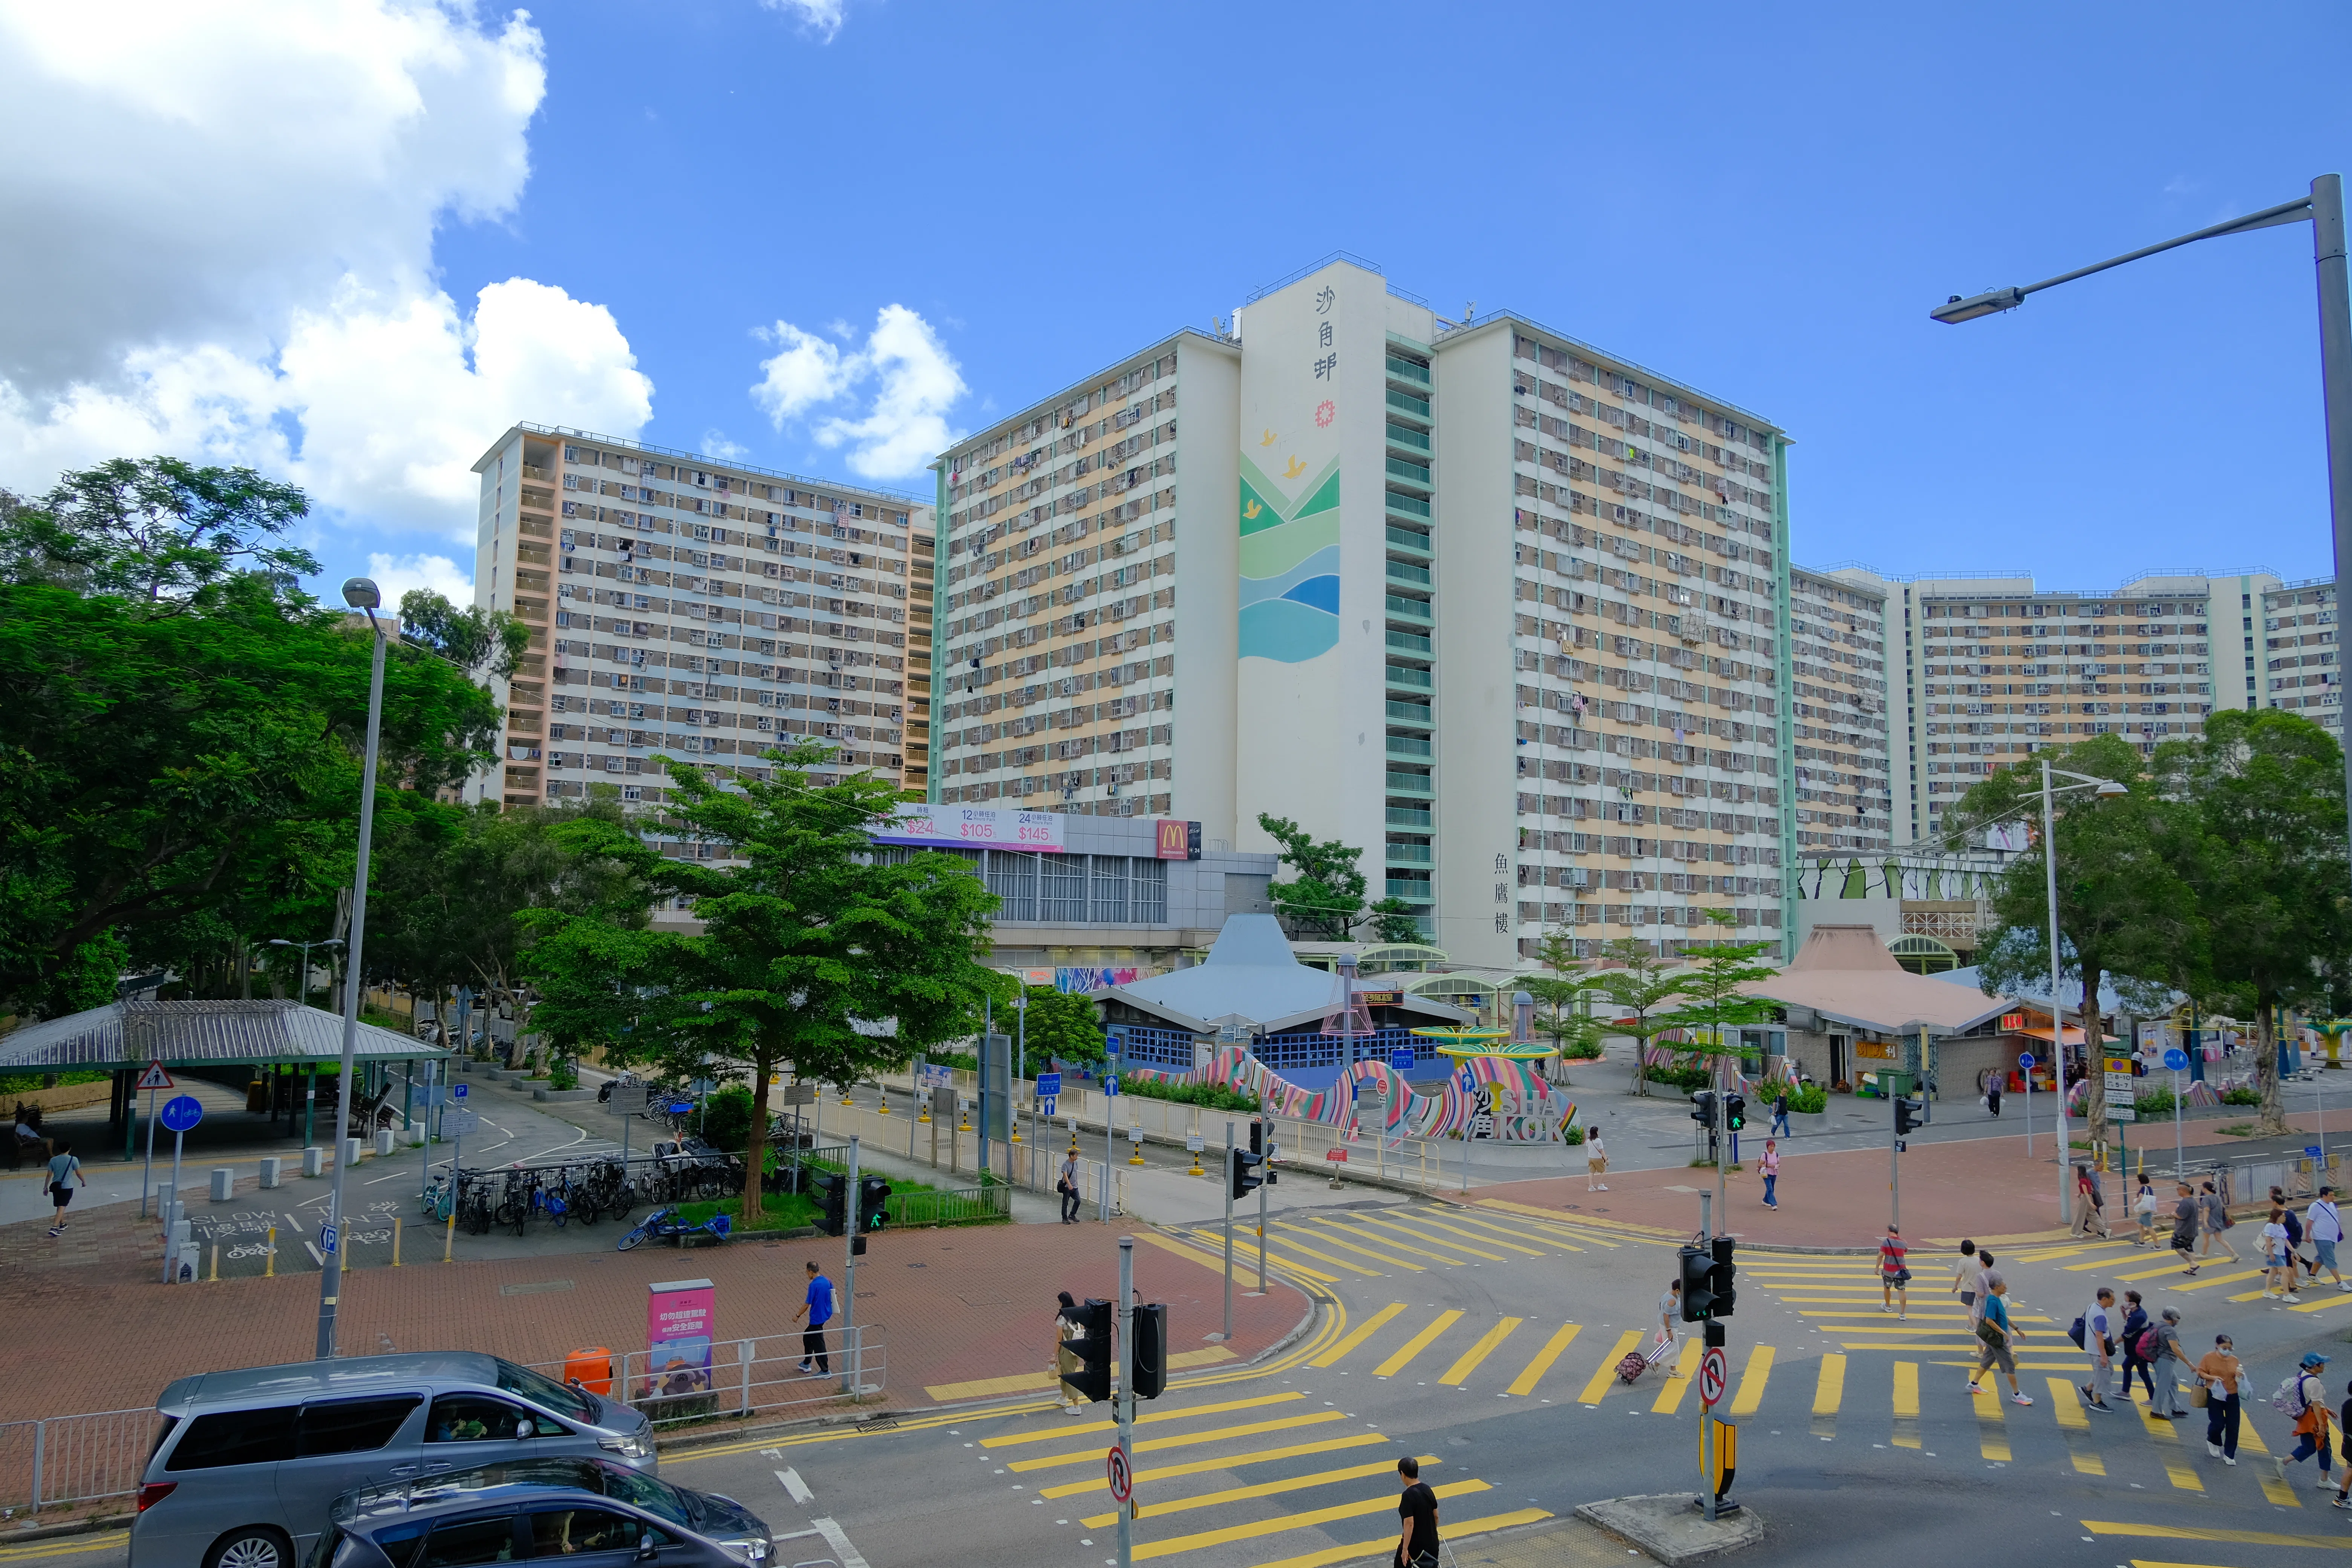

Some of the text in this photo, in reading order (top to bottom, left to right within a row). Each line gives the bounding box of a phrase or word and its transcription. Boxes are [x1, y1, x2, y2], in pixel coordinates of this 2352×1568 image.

[1314, 285, 1337, 382] 沙角邨
[962, 810, 972, 820] 12
[1019, 813, 1031, 823] 24
[906, 819, 933, 834] $24
[960, 822, 992, 838] $105
[1018, 826, 1049, 841] $145
[1494, 853, 1508, 933] 魚鷹樓
[1499, 1089, 1561, 1118] SHA
[1471, 1087, 1494, 1139] 沙角
[1499, 1114, 1567, 1145] KOK
[191, 1210, 276, 1225] SLOW
[198, 1220, 285, 1239] 慢駛
[328, 1232, 334, 1248] P
[660, 1309, 706, 1321] 切勿超速駕駛
[662, 1321, 703, 1333] 保持安全距離
